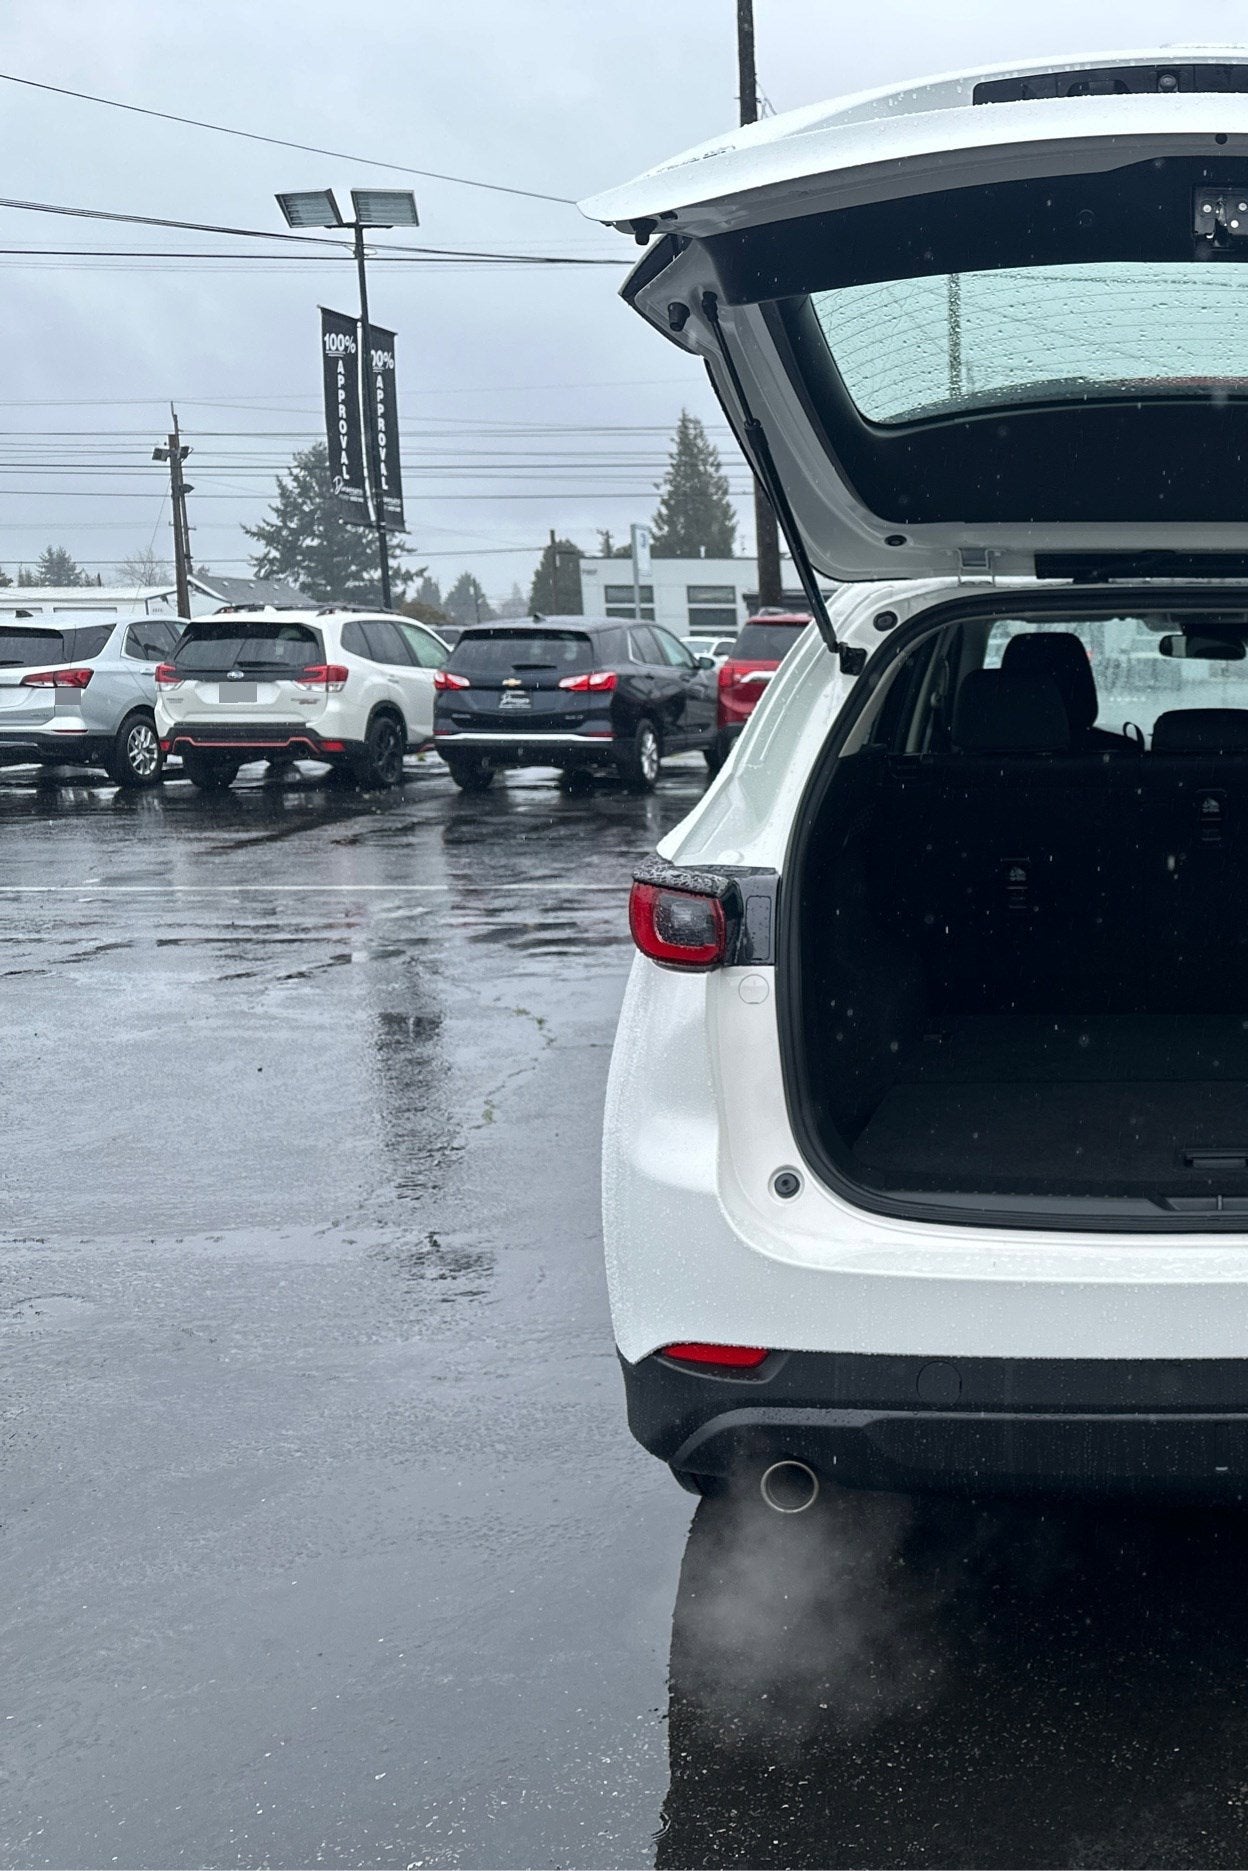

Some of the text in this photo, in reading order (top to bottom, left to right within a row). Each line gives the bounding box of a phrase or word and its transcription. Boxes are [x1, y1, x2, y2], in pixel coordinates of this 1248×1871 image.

[324, 333, 356, 354] 100%
[336, 359, 350, 480] APPROVAL
[375, 375, 389, 490] APPROVAL
